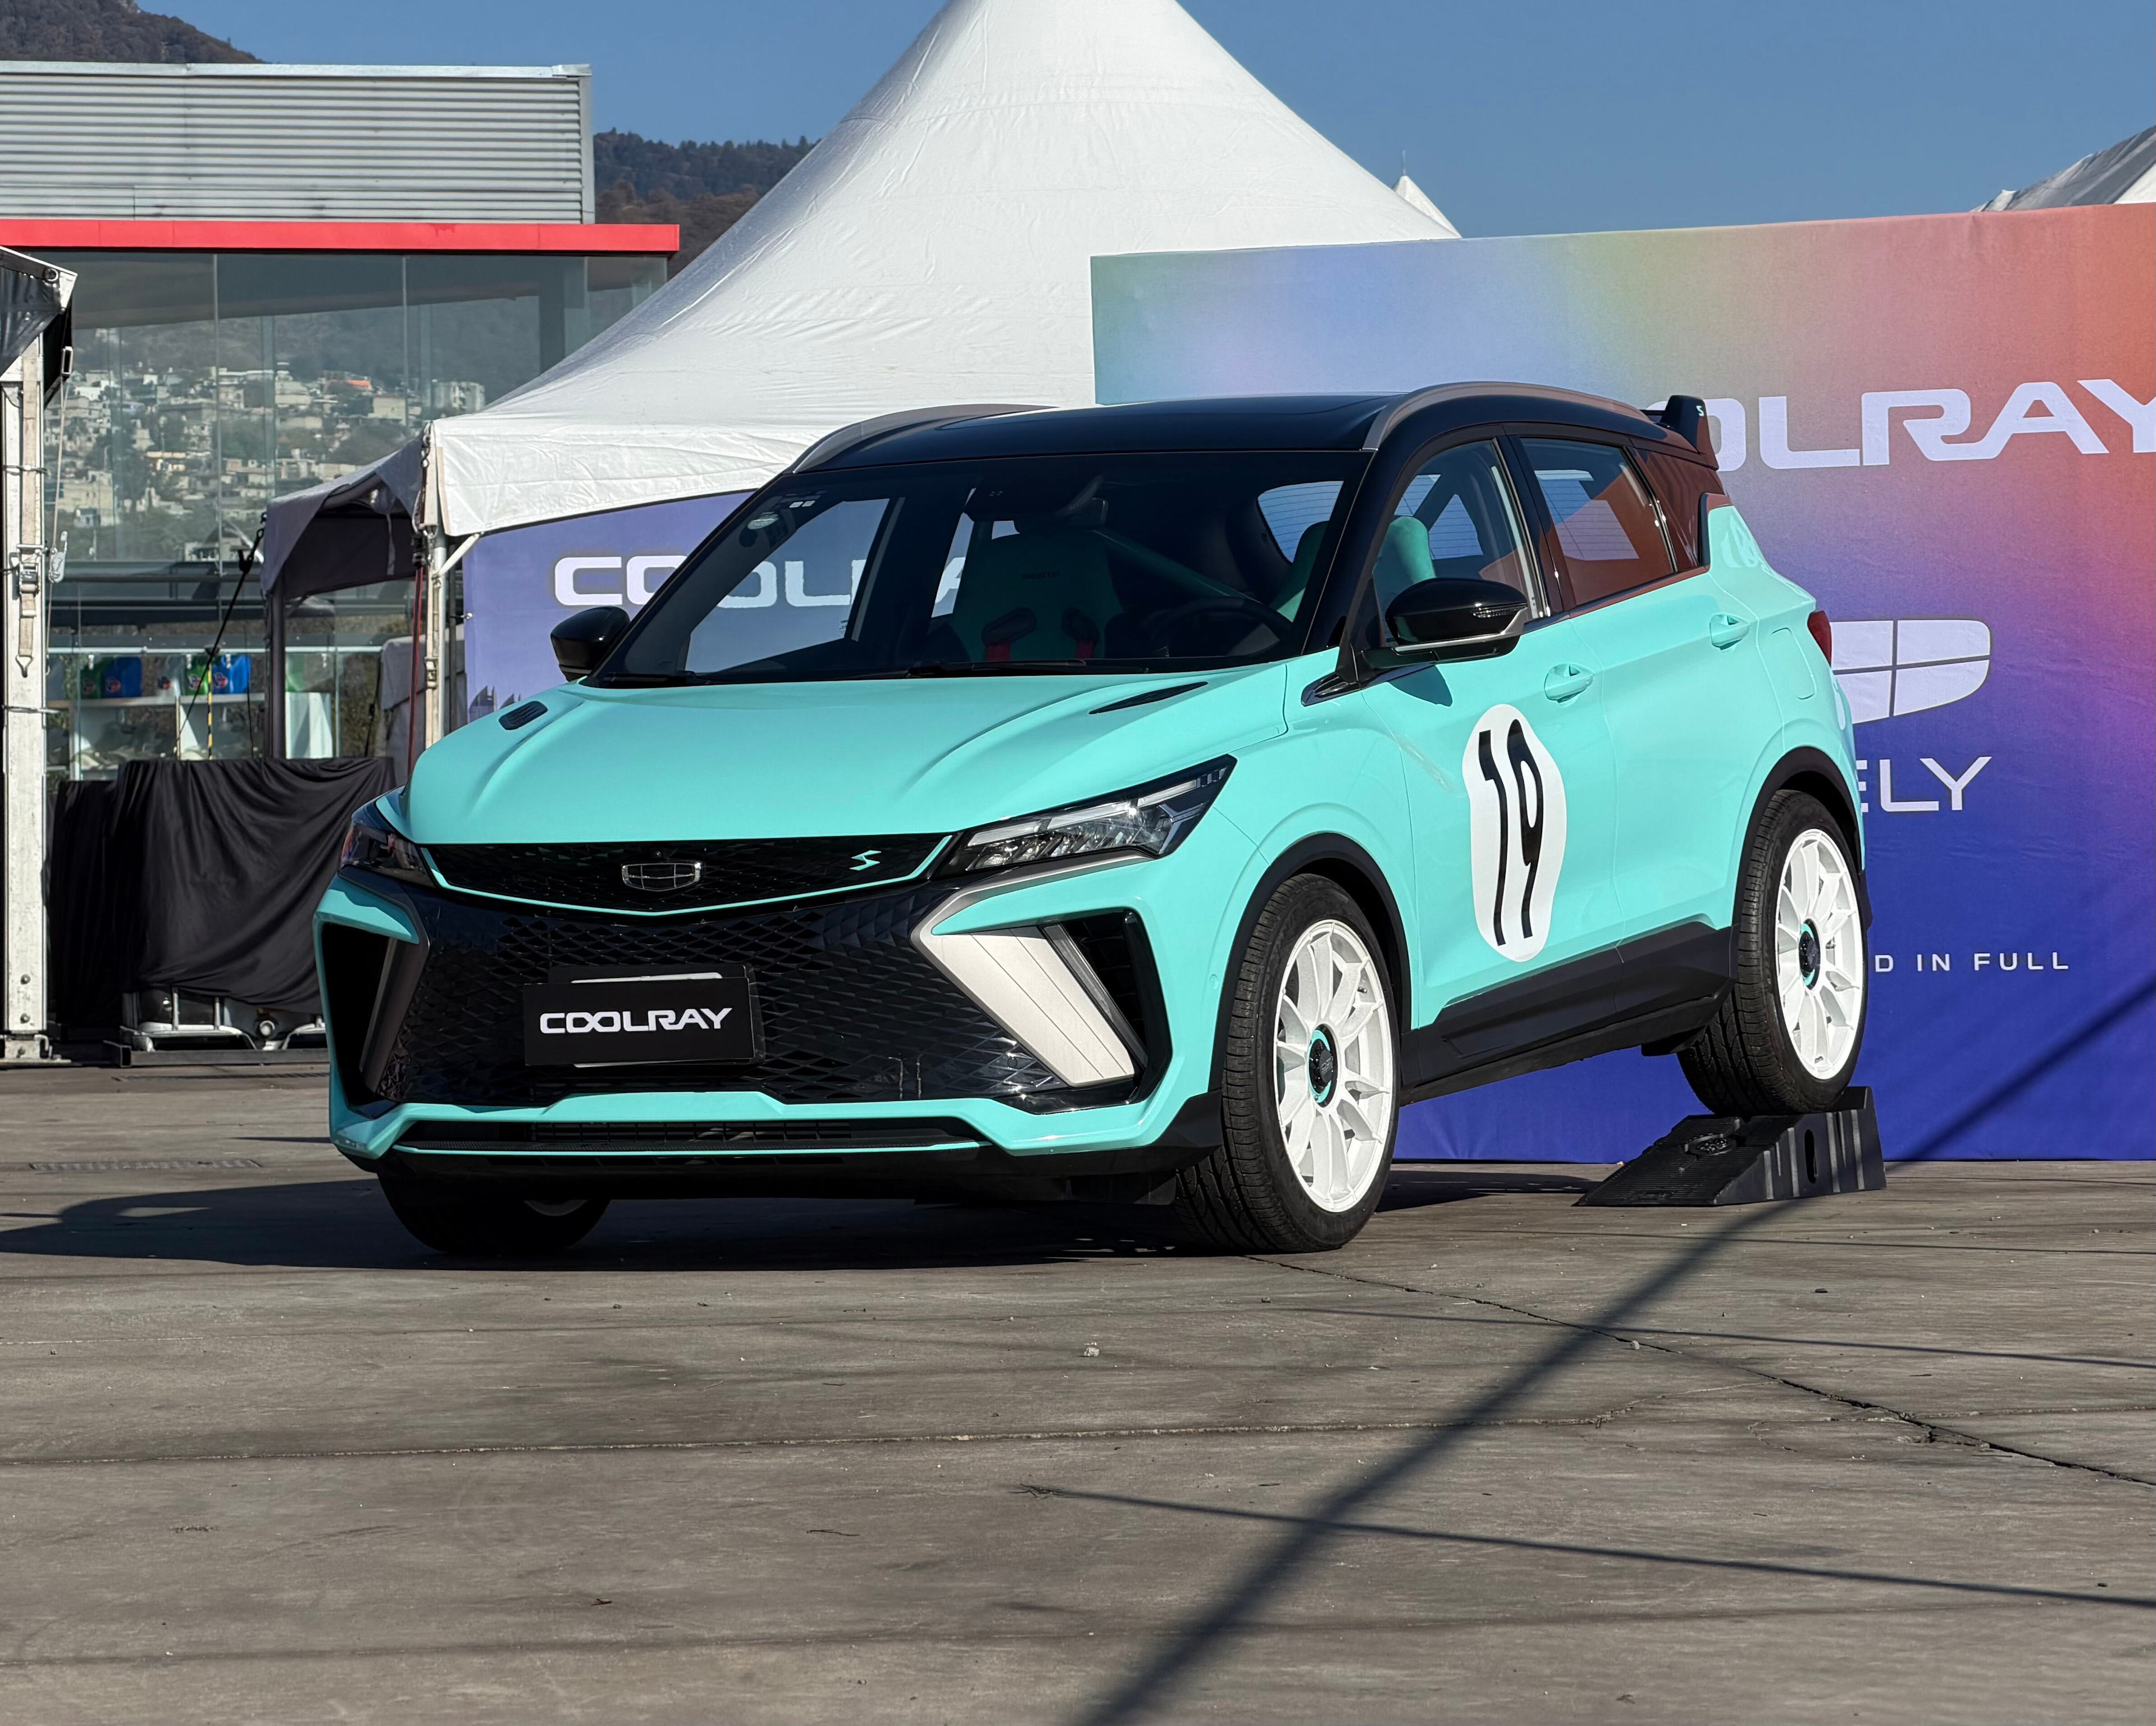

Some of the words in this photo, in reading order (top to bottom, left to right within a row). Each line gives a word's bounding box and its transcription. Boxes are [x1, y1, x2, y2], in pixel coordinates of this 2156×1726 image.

[1478, 718, 1544, 947] 19
[1916, 953, 1950, 972] IN
[1973, 951, 2070, 971] FULL
[539, 1007, 732, 1034] COOLRAY
